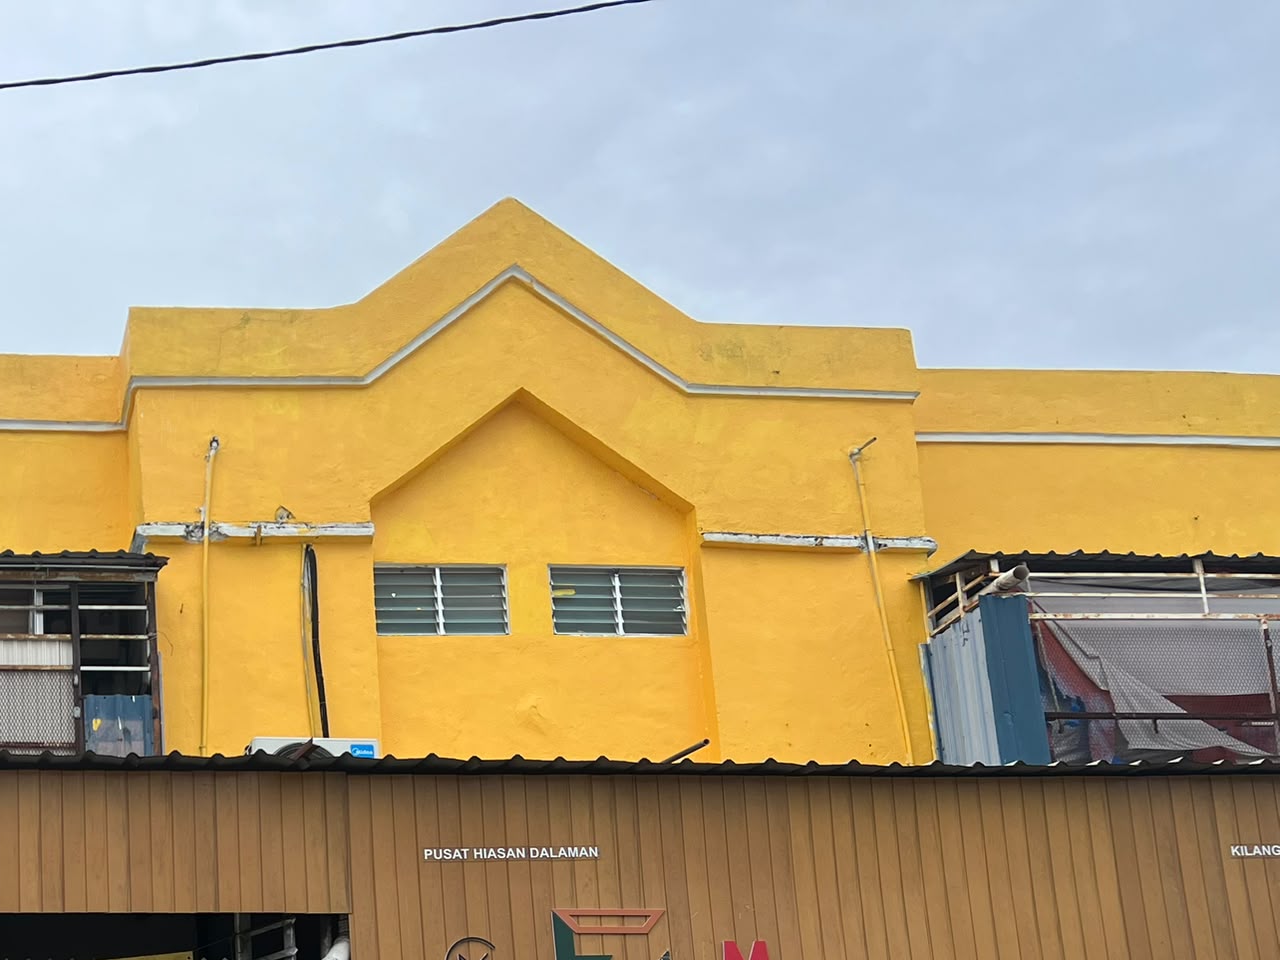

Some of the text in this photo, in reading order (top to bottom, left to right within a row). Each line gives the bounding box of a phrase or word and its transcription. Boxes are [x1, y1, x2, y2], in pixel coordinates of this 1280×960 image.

[424, 846, 599, 860] PUSAT HIASAN DALAMAN
[1231, 844, 1280, 857] KILANG
